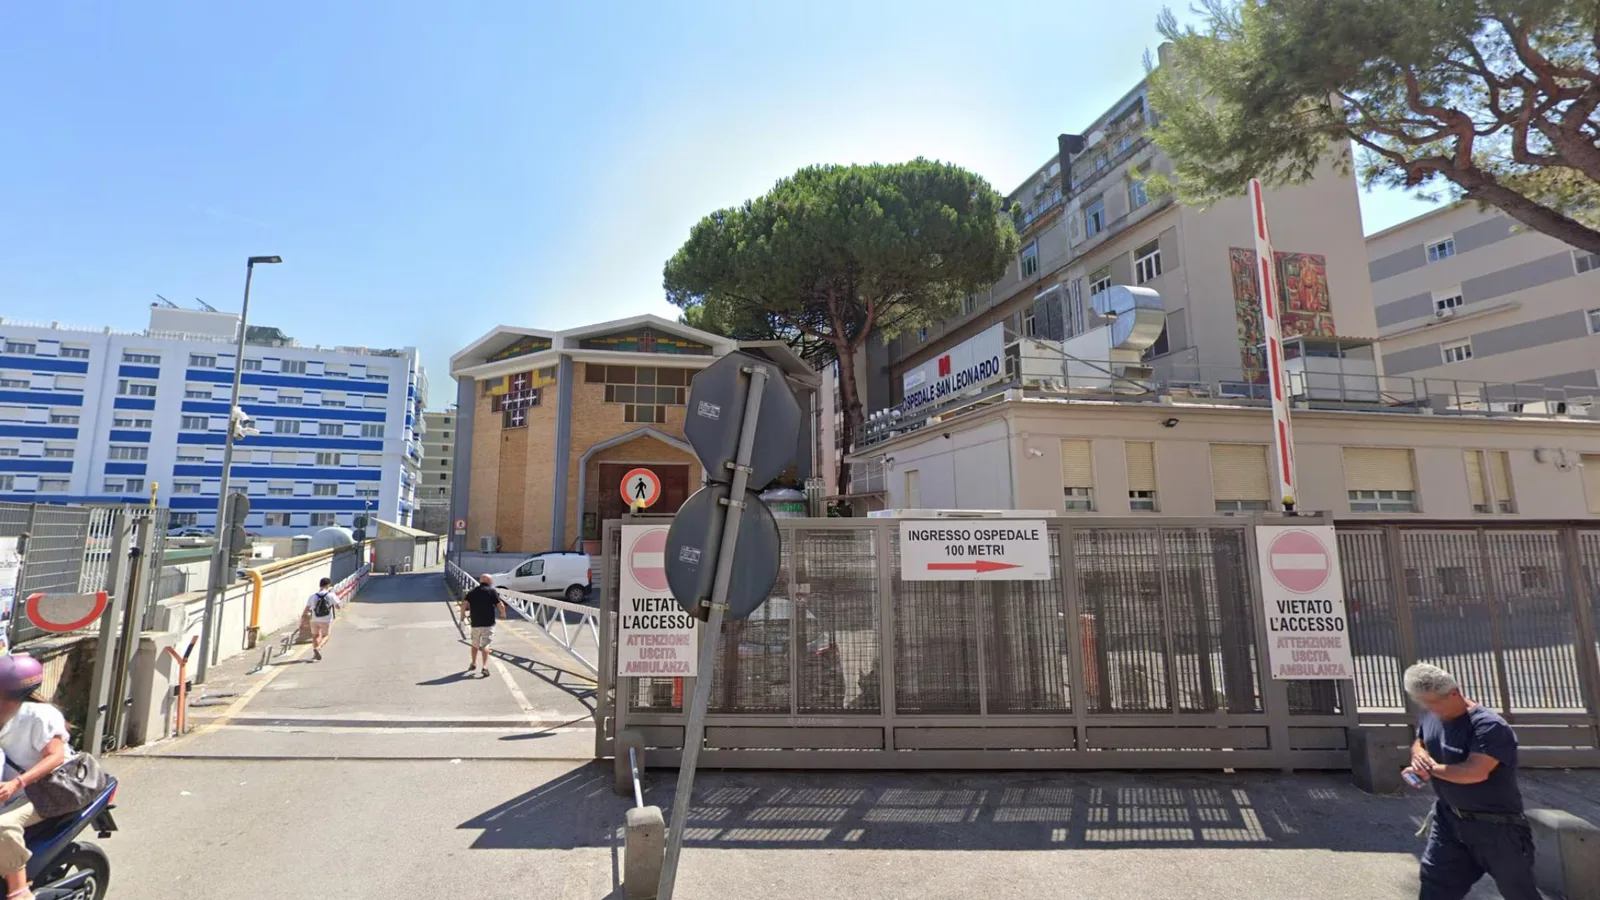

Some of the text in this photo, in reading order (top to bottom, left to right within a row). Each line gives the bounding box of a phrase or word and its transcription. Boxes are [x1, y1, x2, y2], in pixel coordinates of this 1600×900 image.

[902, 384, 935, 412] OSPEDALE
[936, 376, 951, 399] SAN
[952, 356, 1000, 392] LEONARDO
[908, 529, 1039, 541] INGRESSO OSPEDALE
[944, 544, 1005, 556] 100 METRI
[1276, 600, 1333, 614] VIETATO
[623, 614, 695, 629] L'ACCESSO
[1270, 617, 1344, 631] L'ACCESSO
[626, 633, 690, 646] ATTENZIONE
[1277, 636, 1342, 648] ATTENZIONE
[639, 647, 677, 659] USCITA
[1291, 650, 1331, 662] USCITA
[625, 660, 690, 673] AMBULANZA
[1279, 663, 1346, 676] AMBULANZA
